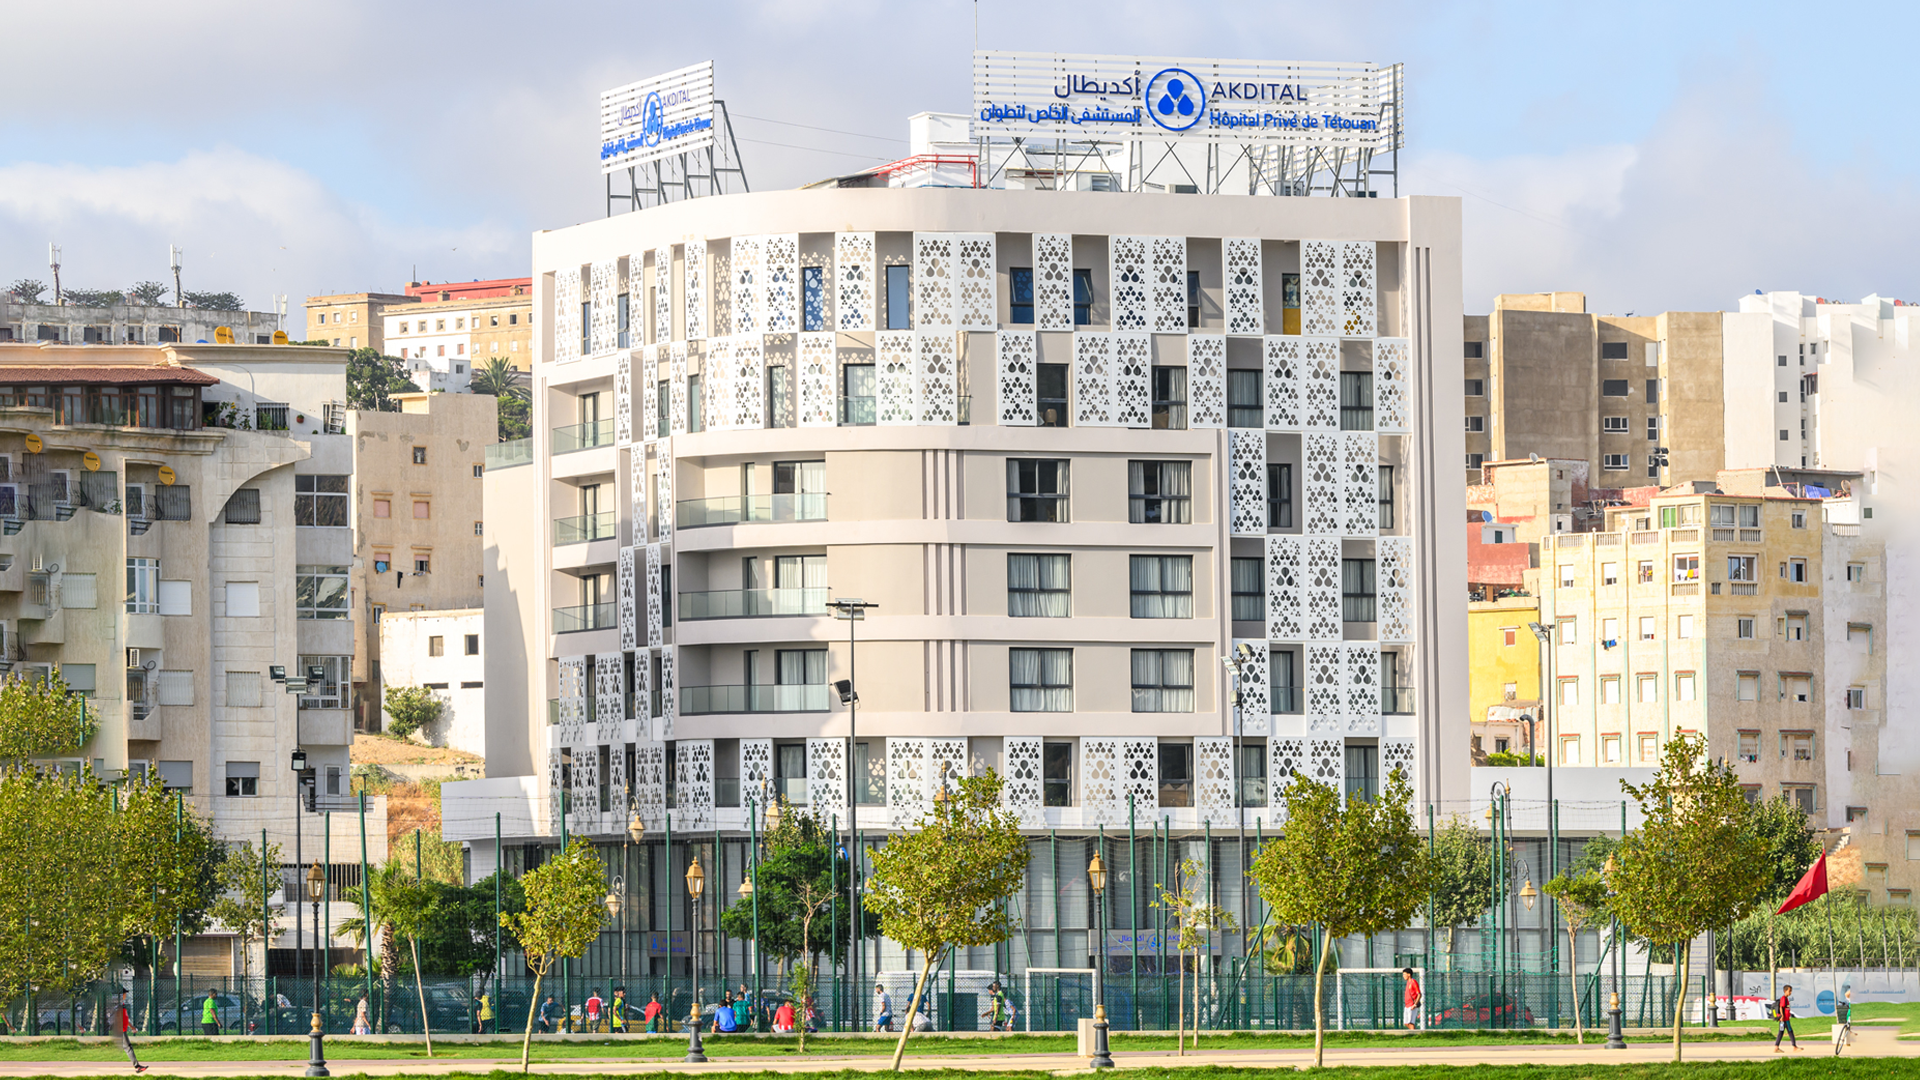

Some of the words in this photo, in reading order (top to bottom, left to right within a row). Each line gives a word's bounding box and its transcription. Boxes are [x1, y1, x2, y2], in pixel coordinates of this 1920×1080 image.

[1054, 69, 1140, 101] أكديطال
[1211, 82, 1308, 101] AKDITAL
[662, 89, 691, 107] AKDITAL
[980, 103, 1026, 123] لتطوان
[1028, 105, 1069, 124] الخاص
[1070, 105, 1141, 125] المستشفى
[1209, 110, 1260, 130] Hôpital
[1263, 113, 1298, 129] Privé
[1301, 114, 1319, 128] de
[1321, 114, 1377, 130] Tétouan
